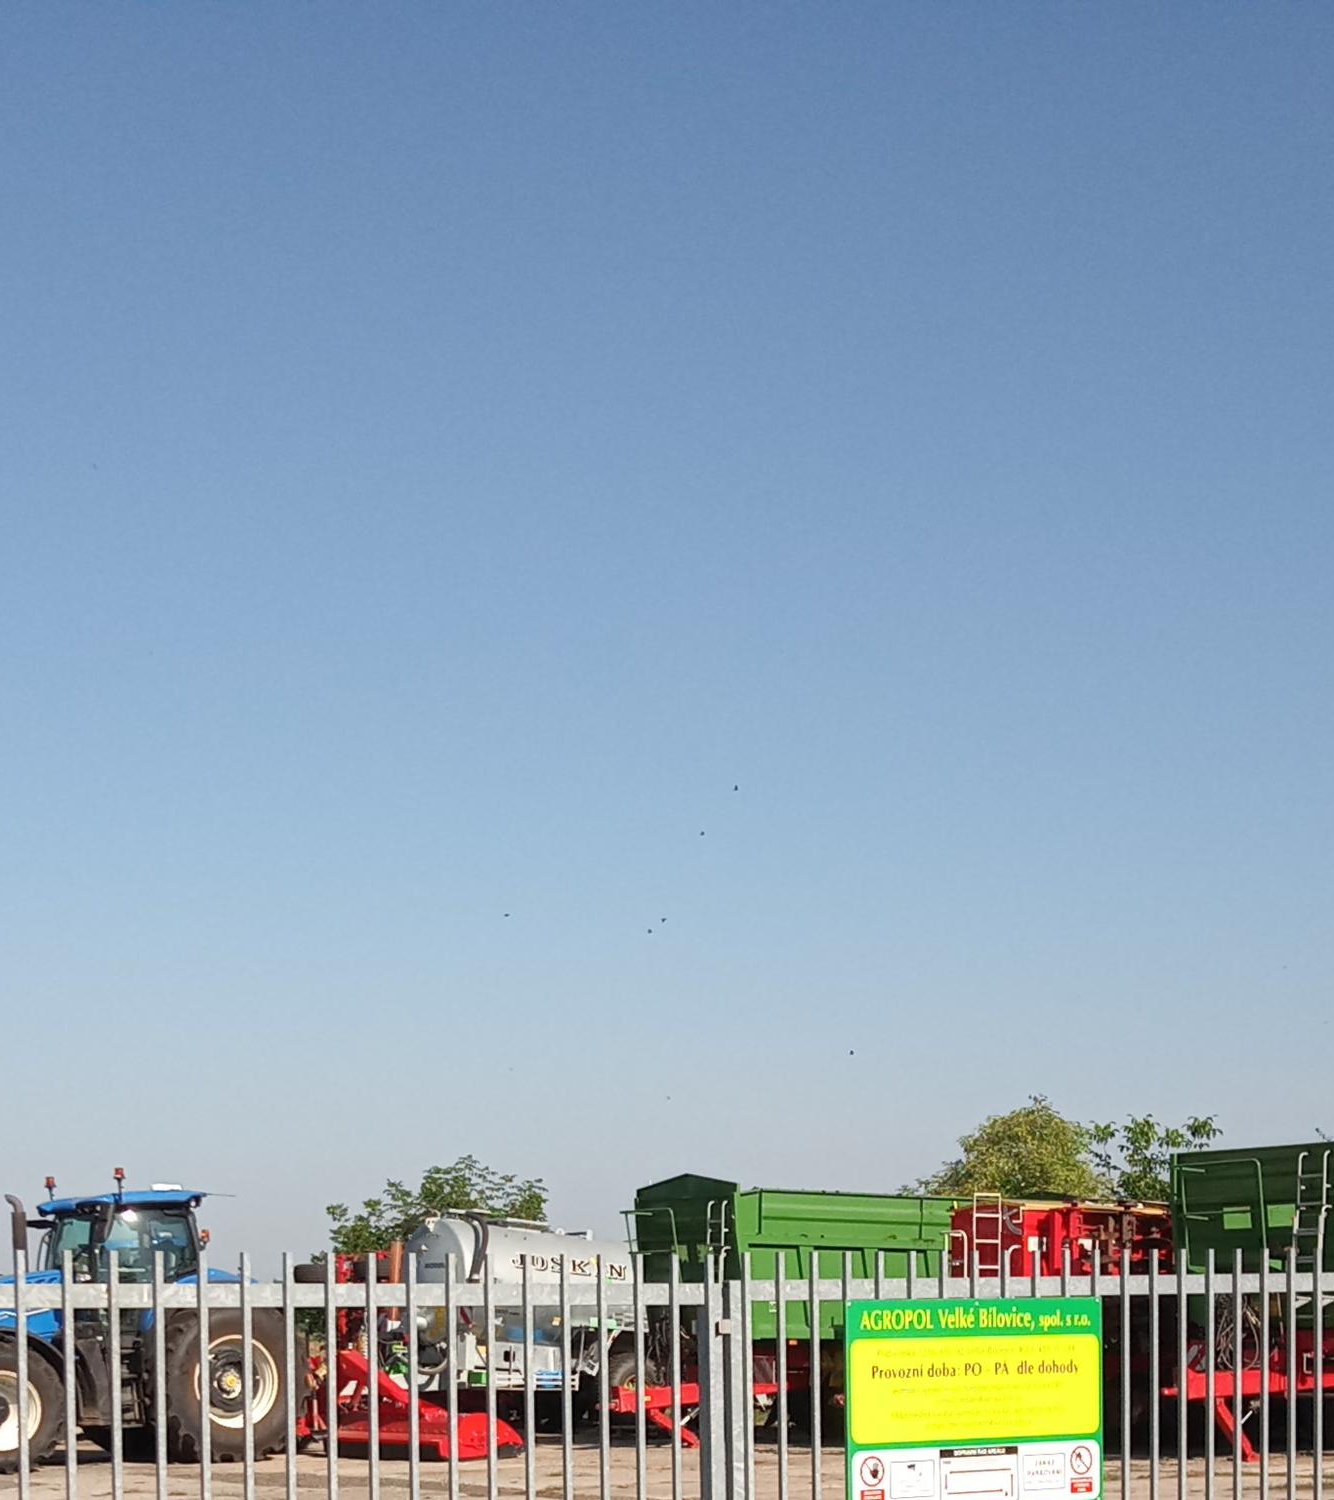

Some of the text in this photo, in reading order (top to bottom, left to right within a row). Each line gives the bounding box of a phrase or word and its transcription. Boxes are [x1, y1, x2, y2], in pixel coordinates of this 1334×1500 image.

[512, 1252, 627, 1280] JOSKN
[860, 1309, 934, 1331] AGROPOL
[938, 1307, 975, 1329] Velké
[979, 1306, 1035, 1331] Bílovice,
[1039, 1310, 1063, 1332] spol.
[1074, 1313, 1091, 1327] r.o.
[871, 1364, 924, 1380] Provozní
[927, 1362, 960, 1378] doba:
[964, 1362, 982, 1377] PO
[1017, 1360, 1034, 1375] dle
[1038, 1359, 1079, 1376] dohody
